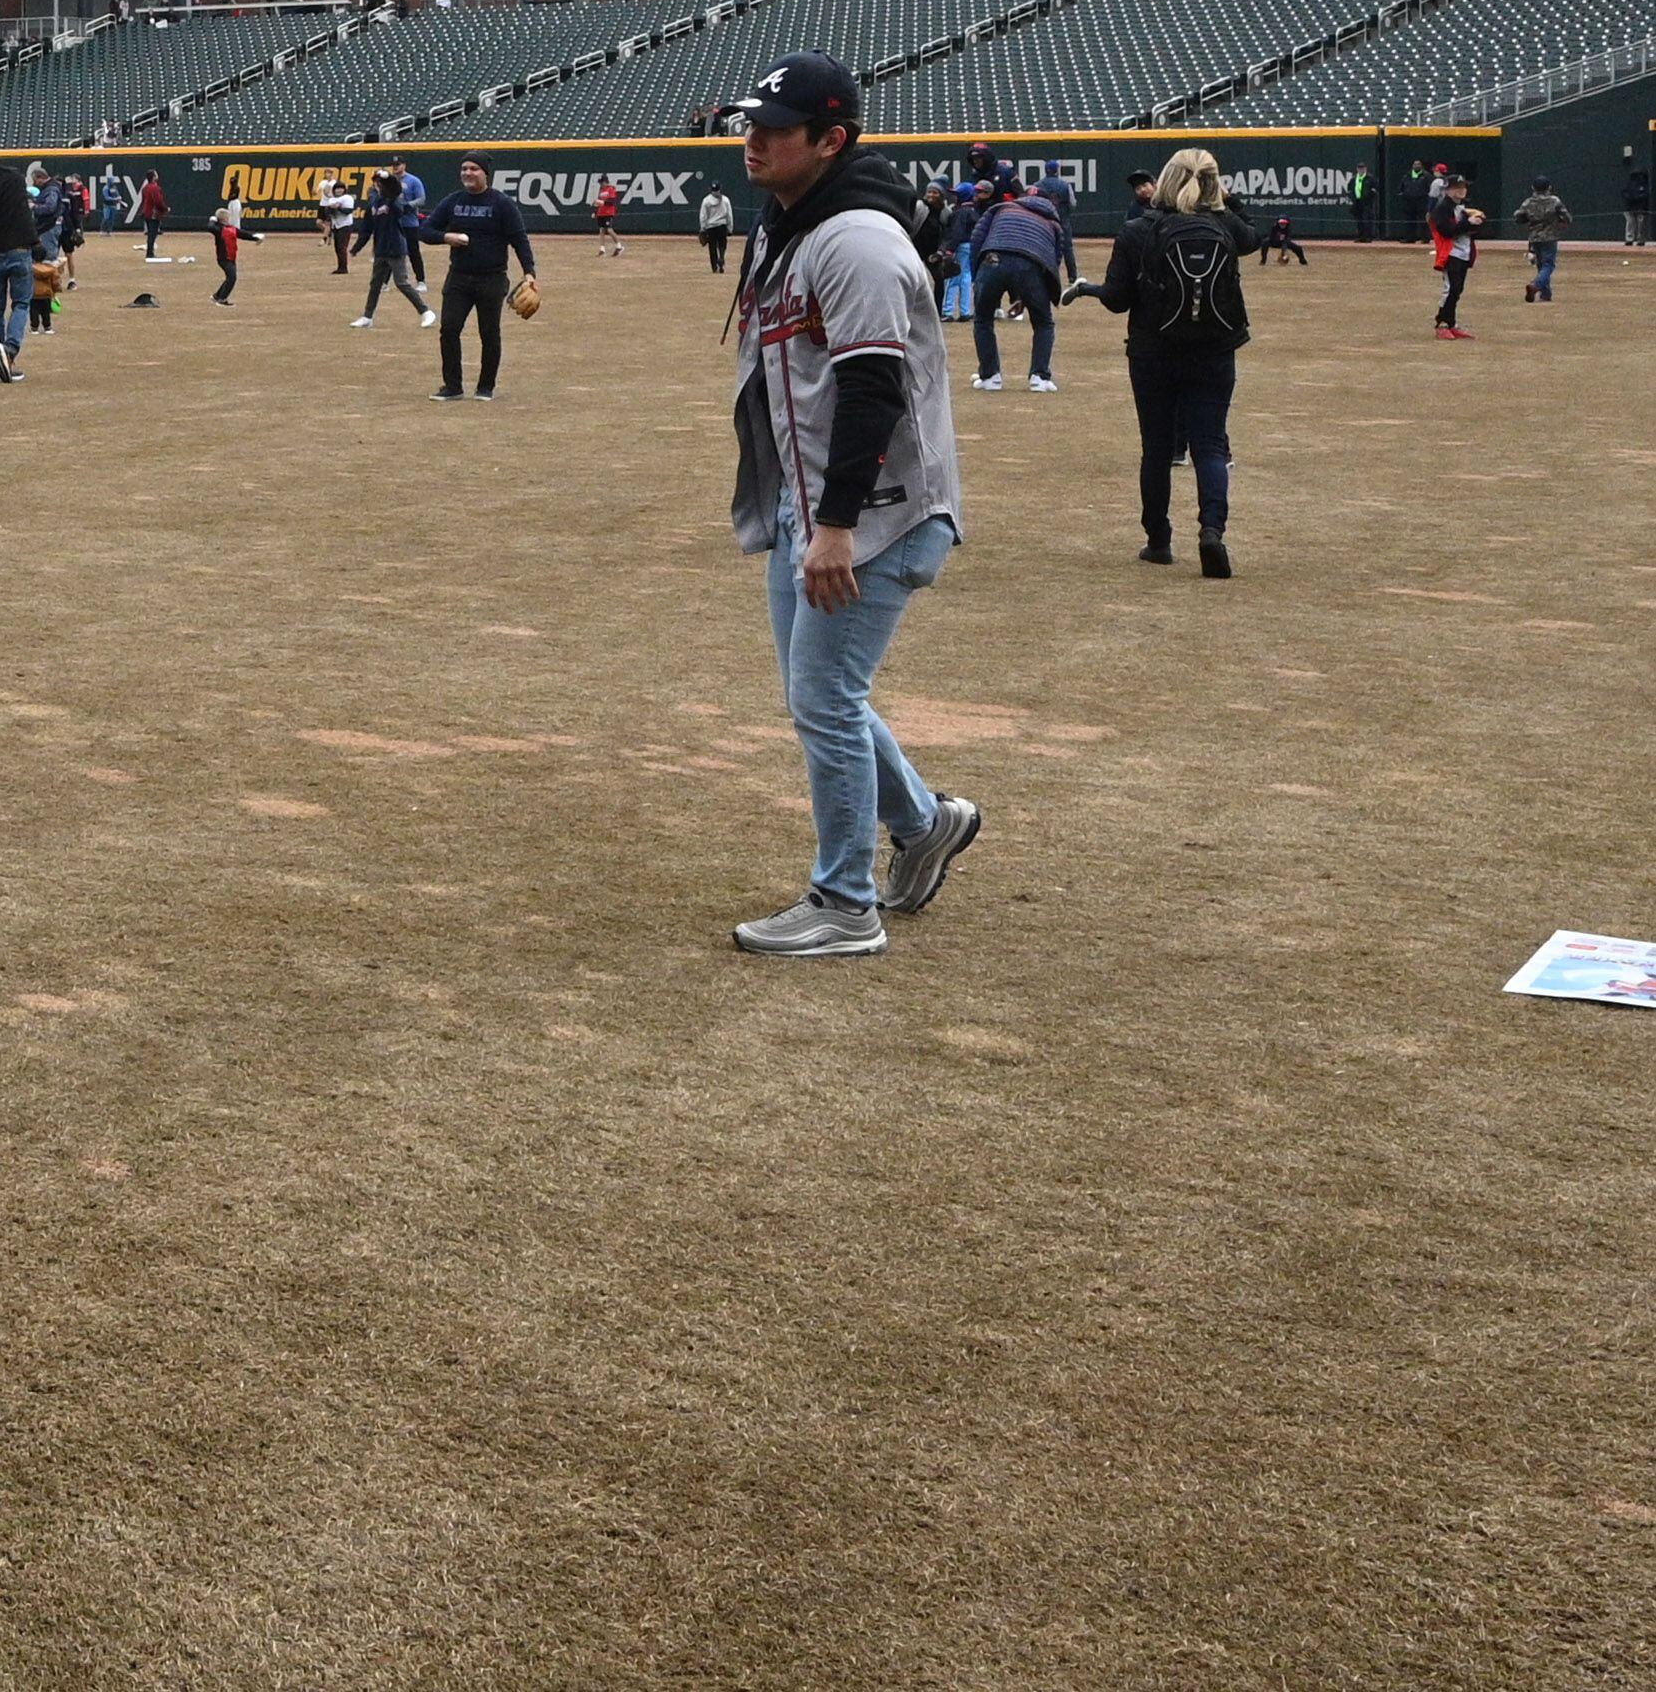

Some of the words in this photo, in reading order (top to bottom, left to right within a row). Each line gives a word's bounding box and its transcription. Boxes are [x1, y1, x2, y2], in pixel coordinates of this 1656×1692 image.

[191, 158, 211, 171] 385
[1219, 168, 1282, 196] PAPA
[1282, 166, 1353, 196] JOHN
[491, 170, 694, 216] EQUIFAX
[1249, 197, 1306, 207] Ingredients.
[1308, 196, 1337, 205] Better
